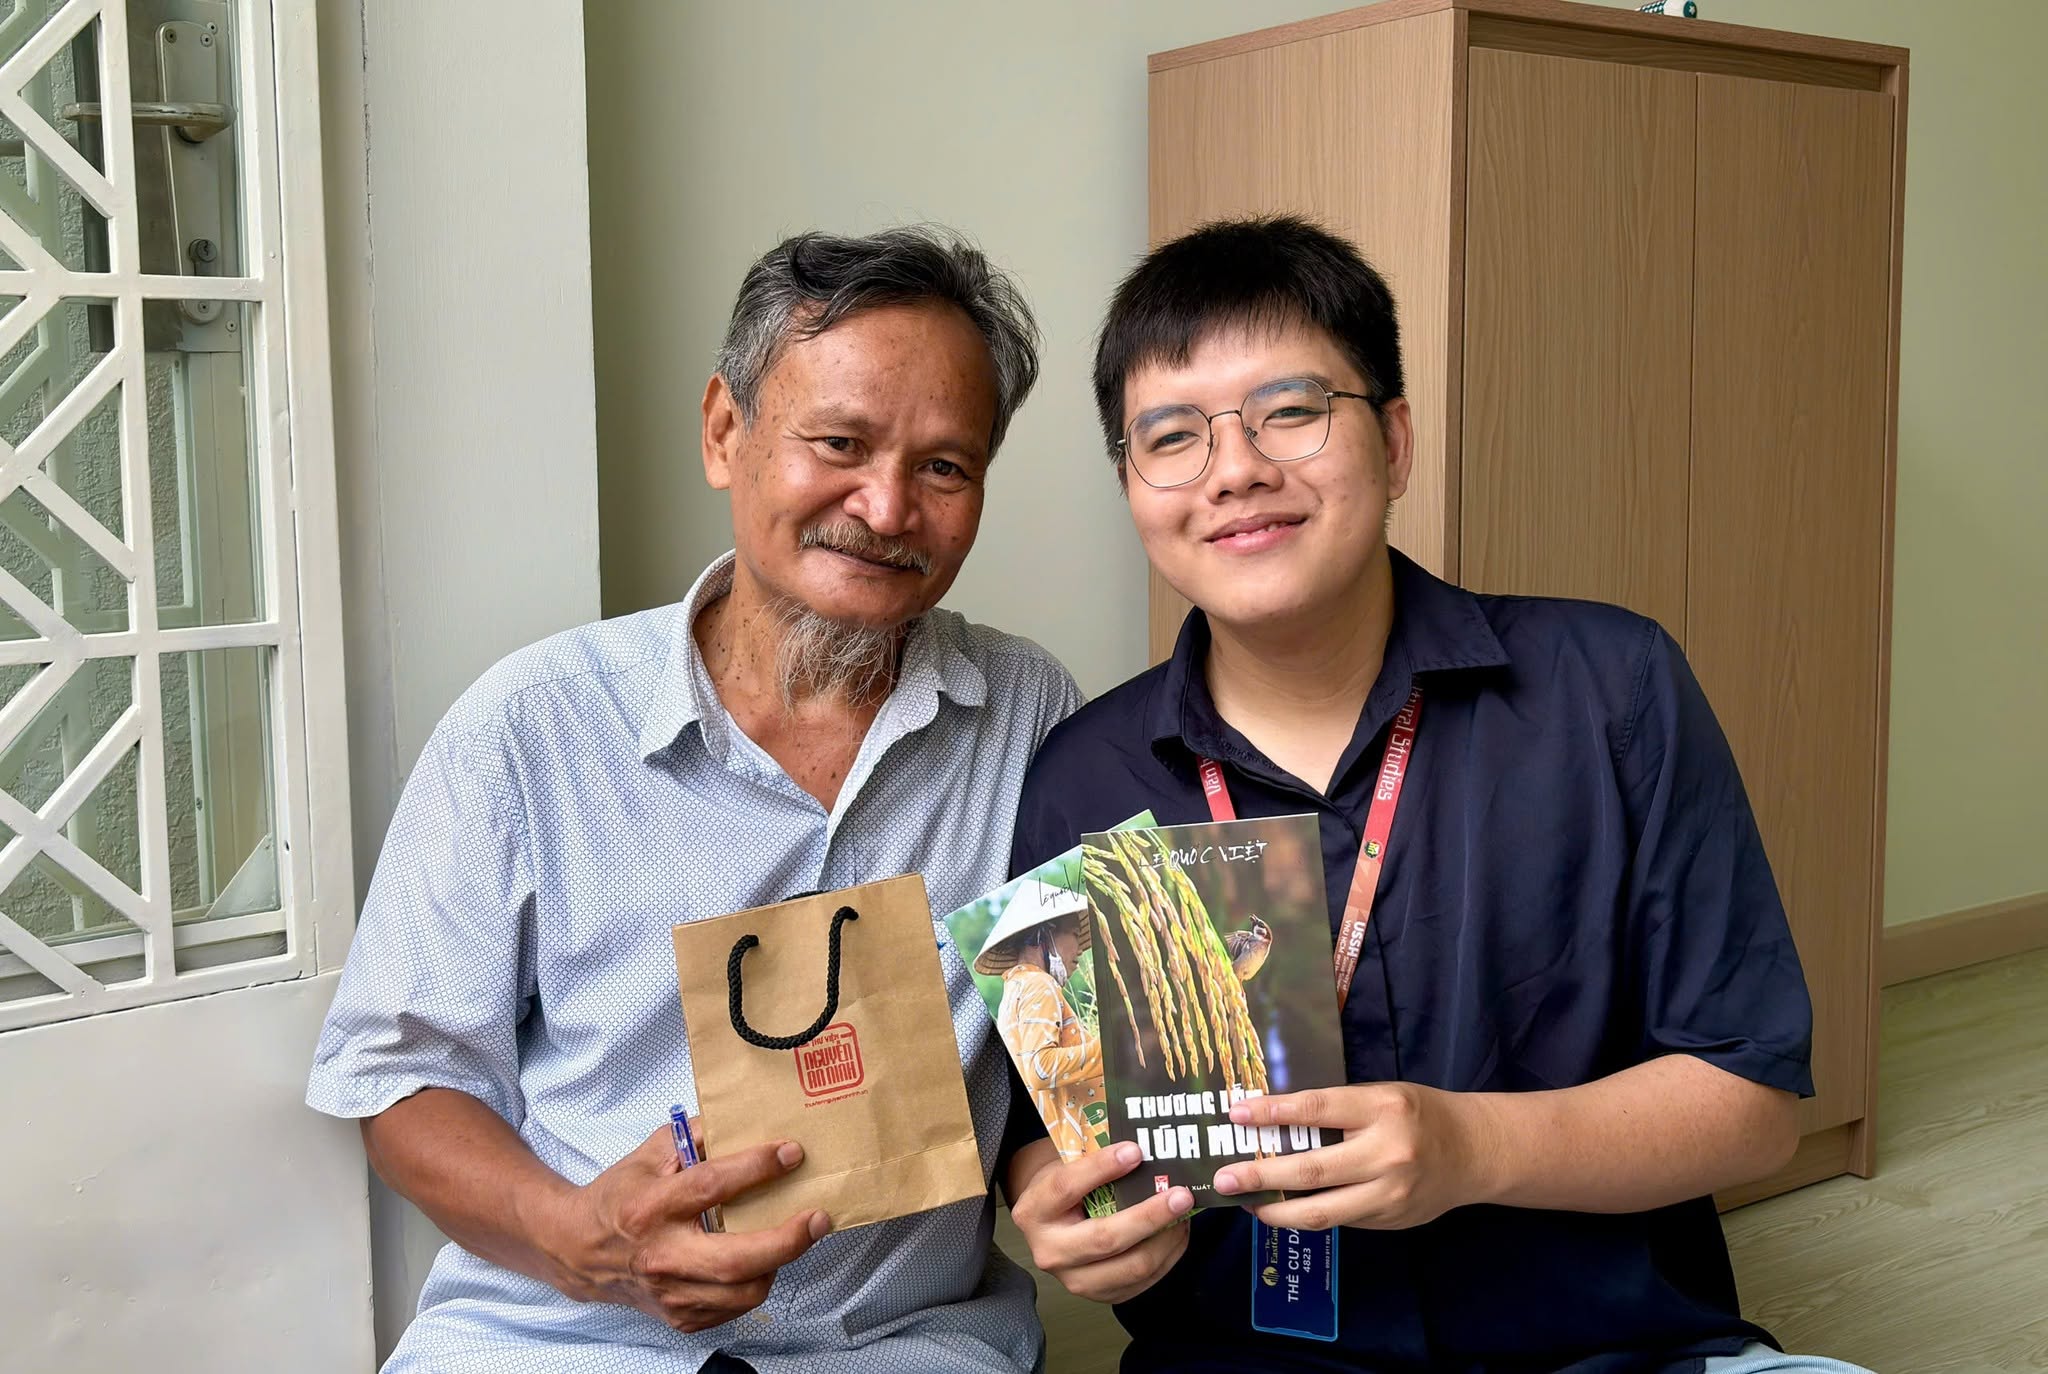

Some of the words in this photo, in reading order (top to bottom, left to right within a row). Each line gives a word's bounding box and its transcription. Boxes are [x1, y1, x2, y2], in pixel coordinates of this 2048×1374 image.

[1377, 734, 1410, 800] Studies
[1347, 921, 1366, 958] USSH
[807, 1068, 826, 1089] AN
[1125, 1090, 1216, 1119] THƯƠNG
[1136, 1124, 1201, 1161] LÚA
[1288, 1247, 1300, 1270] CƯ
[1303, 1247, 1312, 1273] 4823
